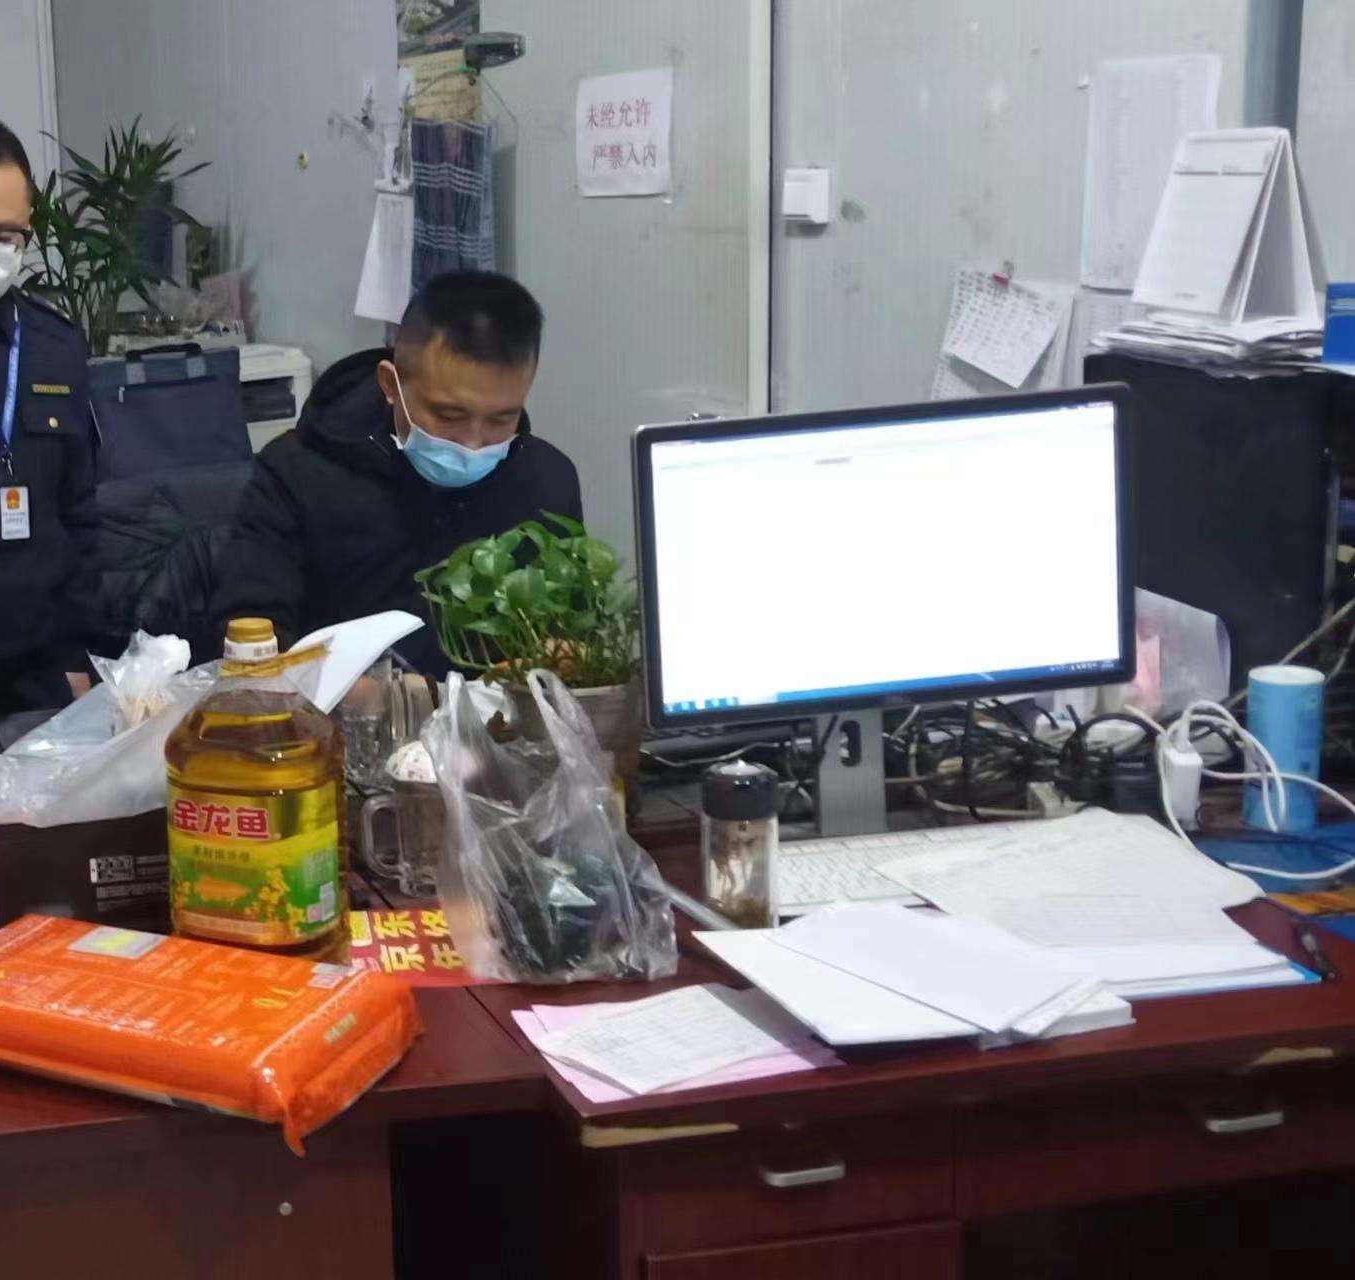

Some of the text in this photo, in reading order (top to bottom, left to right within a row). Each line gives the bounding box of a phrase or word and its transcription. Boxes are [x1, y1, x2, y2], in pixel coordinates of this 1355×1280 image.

[586, 98, 651, 129] 未经允许
[592, 140, 657, 171] 严禁入内
[174, 799, 270, 840] 金龙鱼
